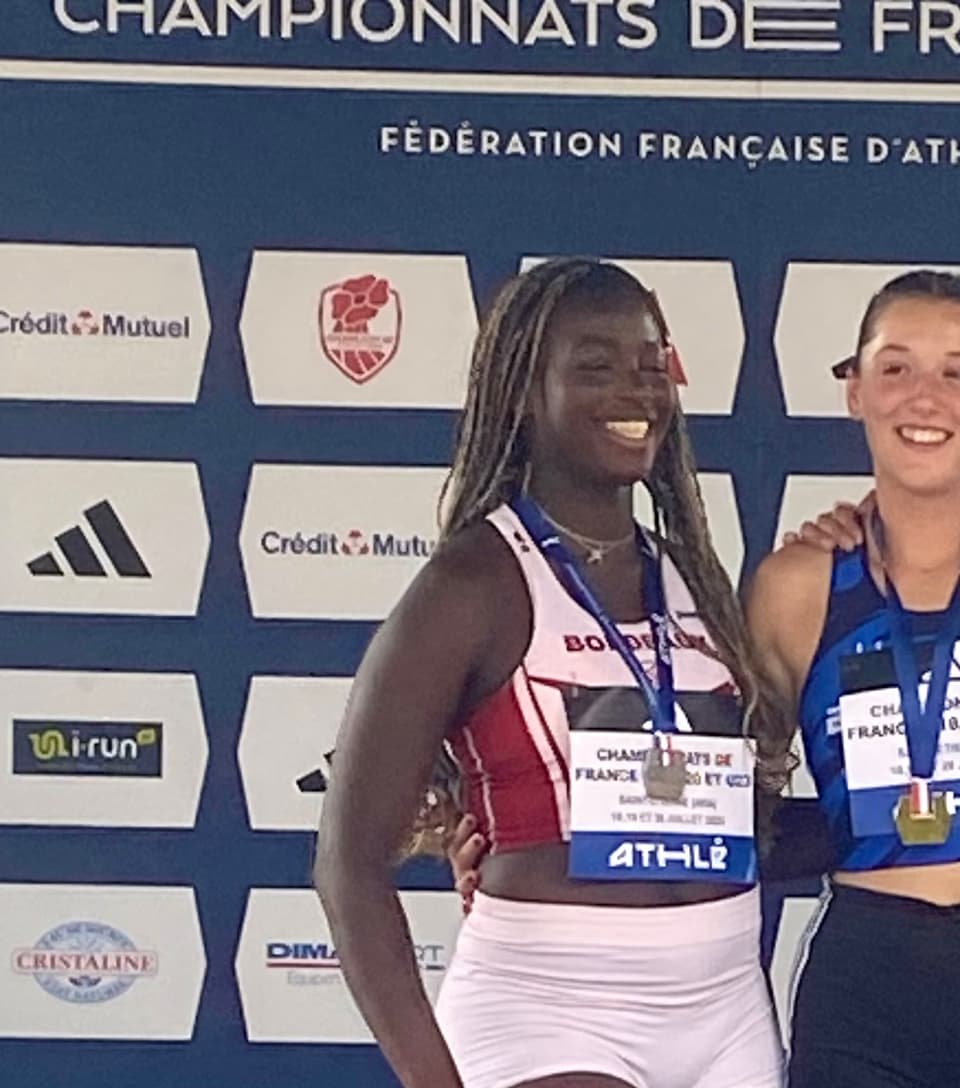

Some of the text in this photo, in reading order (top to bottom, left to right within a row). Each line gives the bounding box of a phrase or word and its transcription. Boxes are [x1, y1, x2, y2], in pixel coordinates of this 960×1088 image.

[53, 0, 658, 49] CHAMPIONNATS
[690, 0, 842, 51] DE
[380, 119, 622, 158] FÉDÉRATION
[638, 132, 849, 169] FRANÇAISE
[0, 311, 190, 339] Crédit Mutuel
[260, 531, 435, 558] Crédit Mutu
[847, 721, 906, 740] FRANC
[575, 767, 639, 782] FRANCE
[608, 836, 729, 871] ATHLÉ
[16, 952, 154, 972] CRISTALINE
